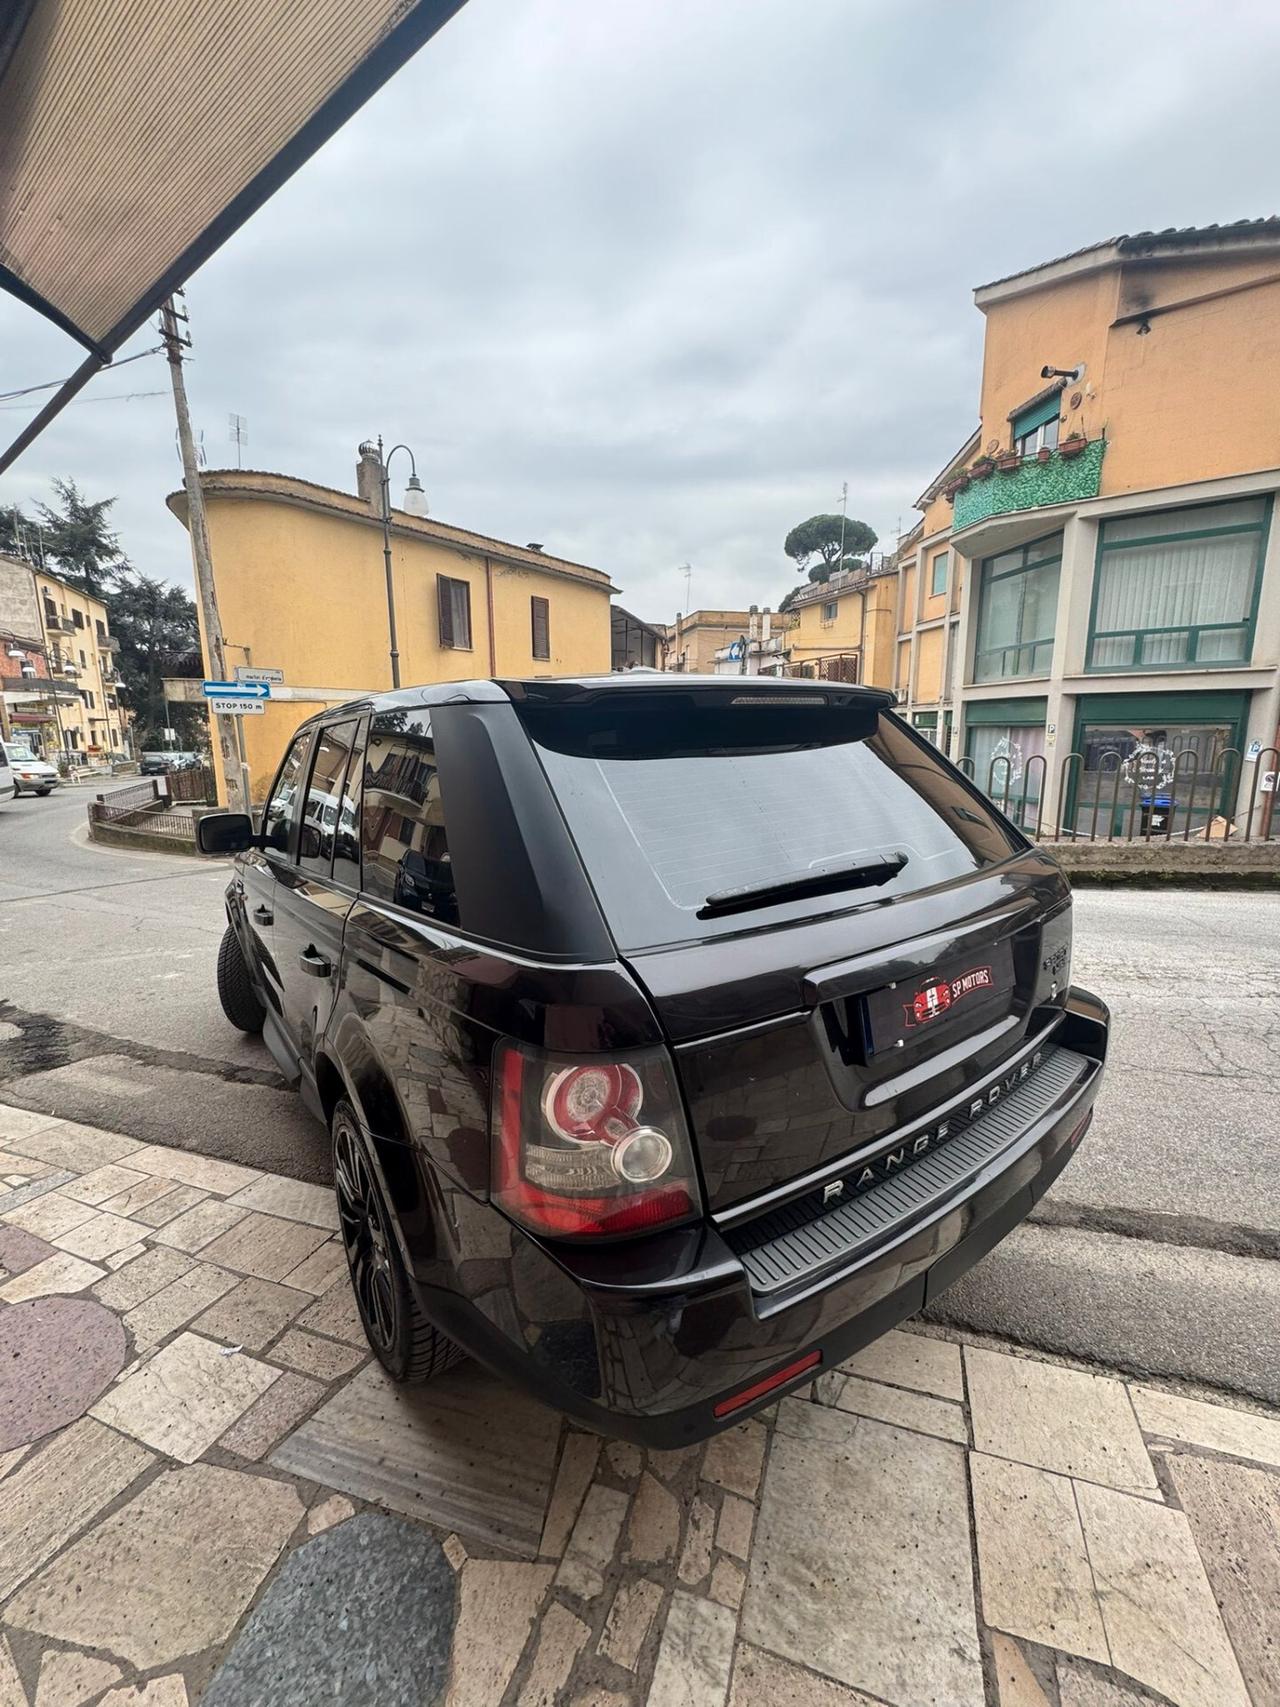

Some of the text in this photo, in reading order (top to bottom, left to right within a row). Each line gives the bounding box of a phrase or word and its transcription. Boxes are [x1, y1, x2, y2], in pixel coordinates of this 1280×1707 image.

[952, 970, 989, 998] SP MOTORS
[824, 1052, 1042, 1204] RANGE ROVER
